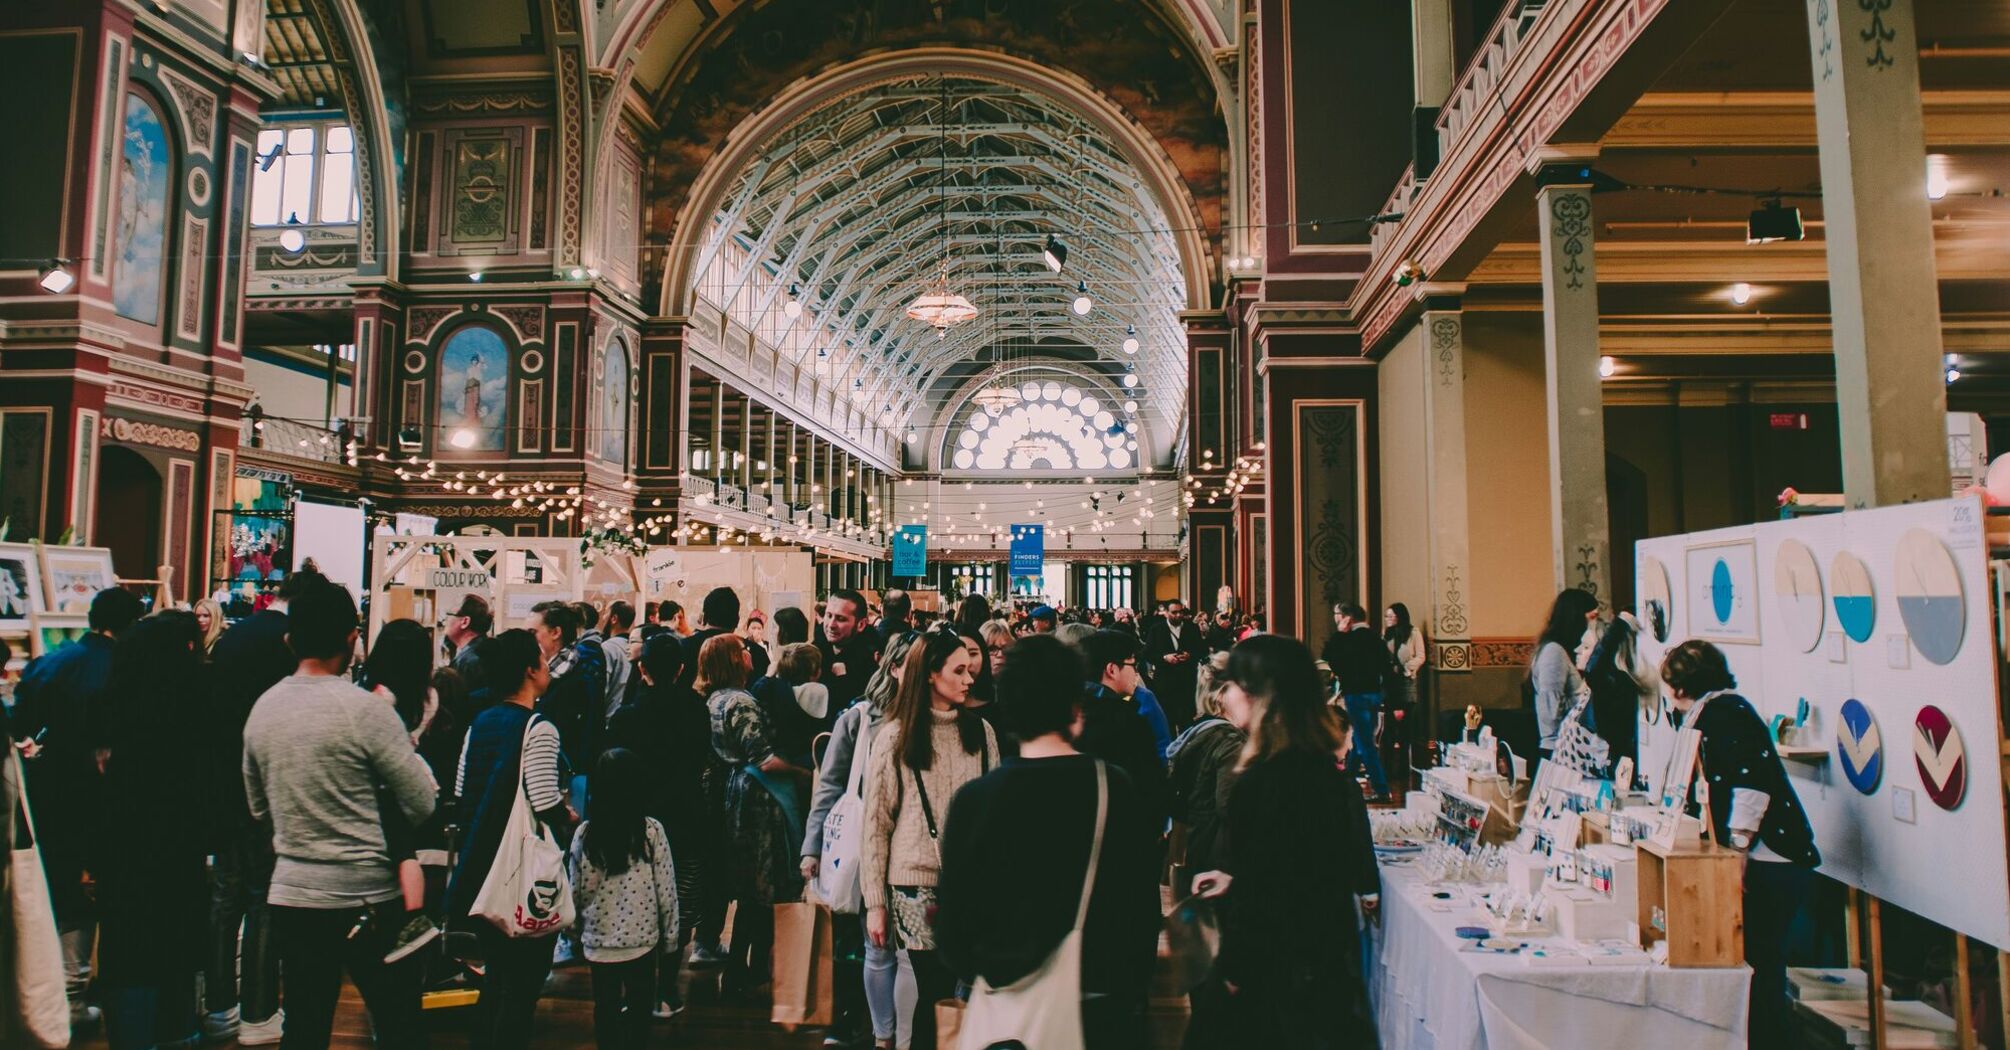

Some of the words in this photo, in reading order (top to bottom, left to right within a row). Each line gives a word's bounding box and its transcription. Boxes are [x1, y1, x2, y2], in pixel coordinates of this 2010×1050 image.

[652, 560, 675, 572] frankie
[897, 558, 921, 566] coffee
[433, 571, 465, 588] COLOUR
